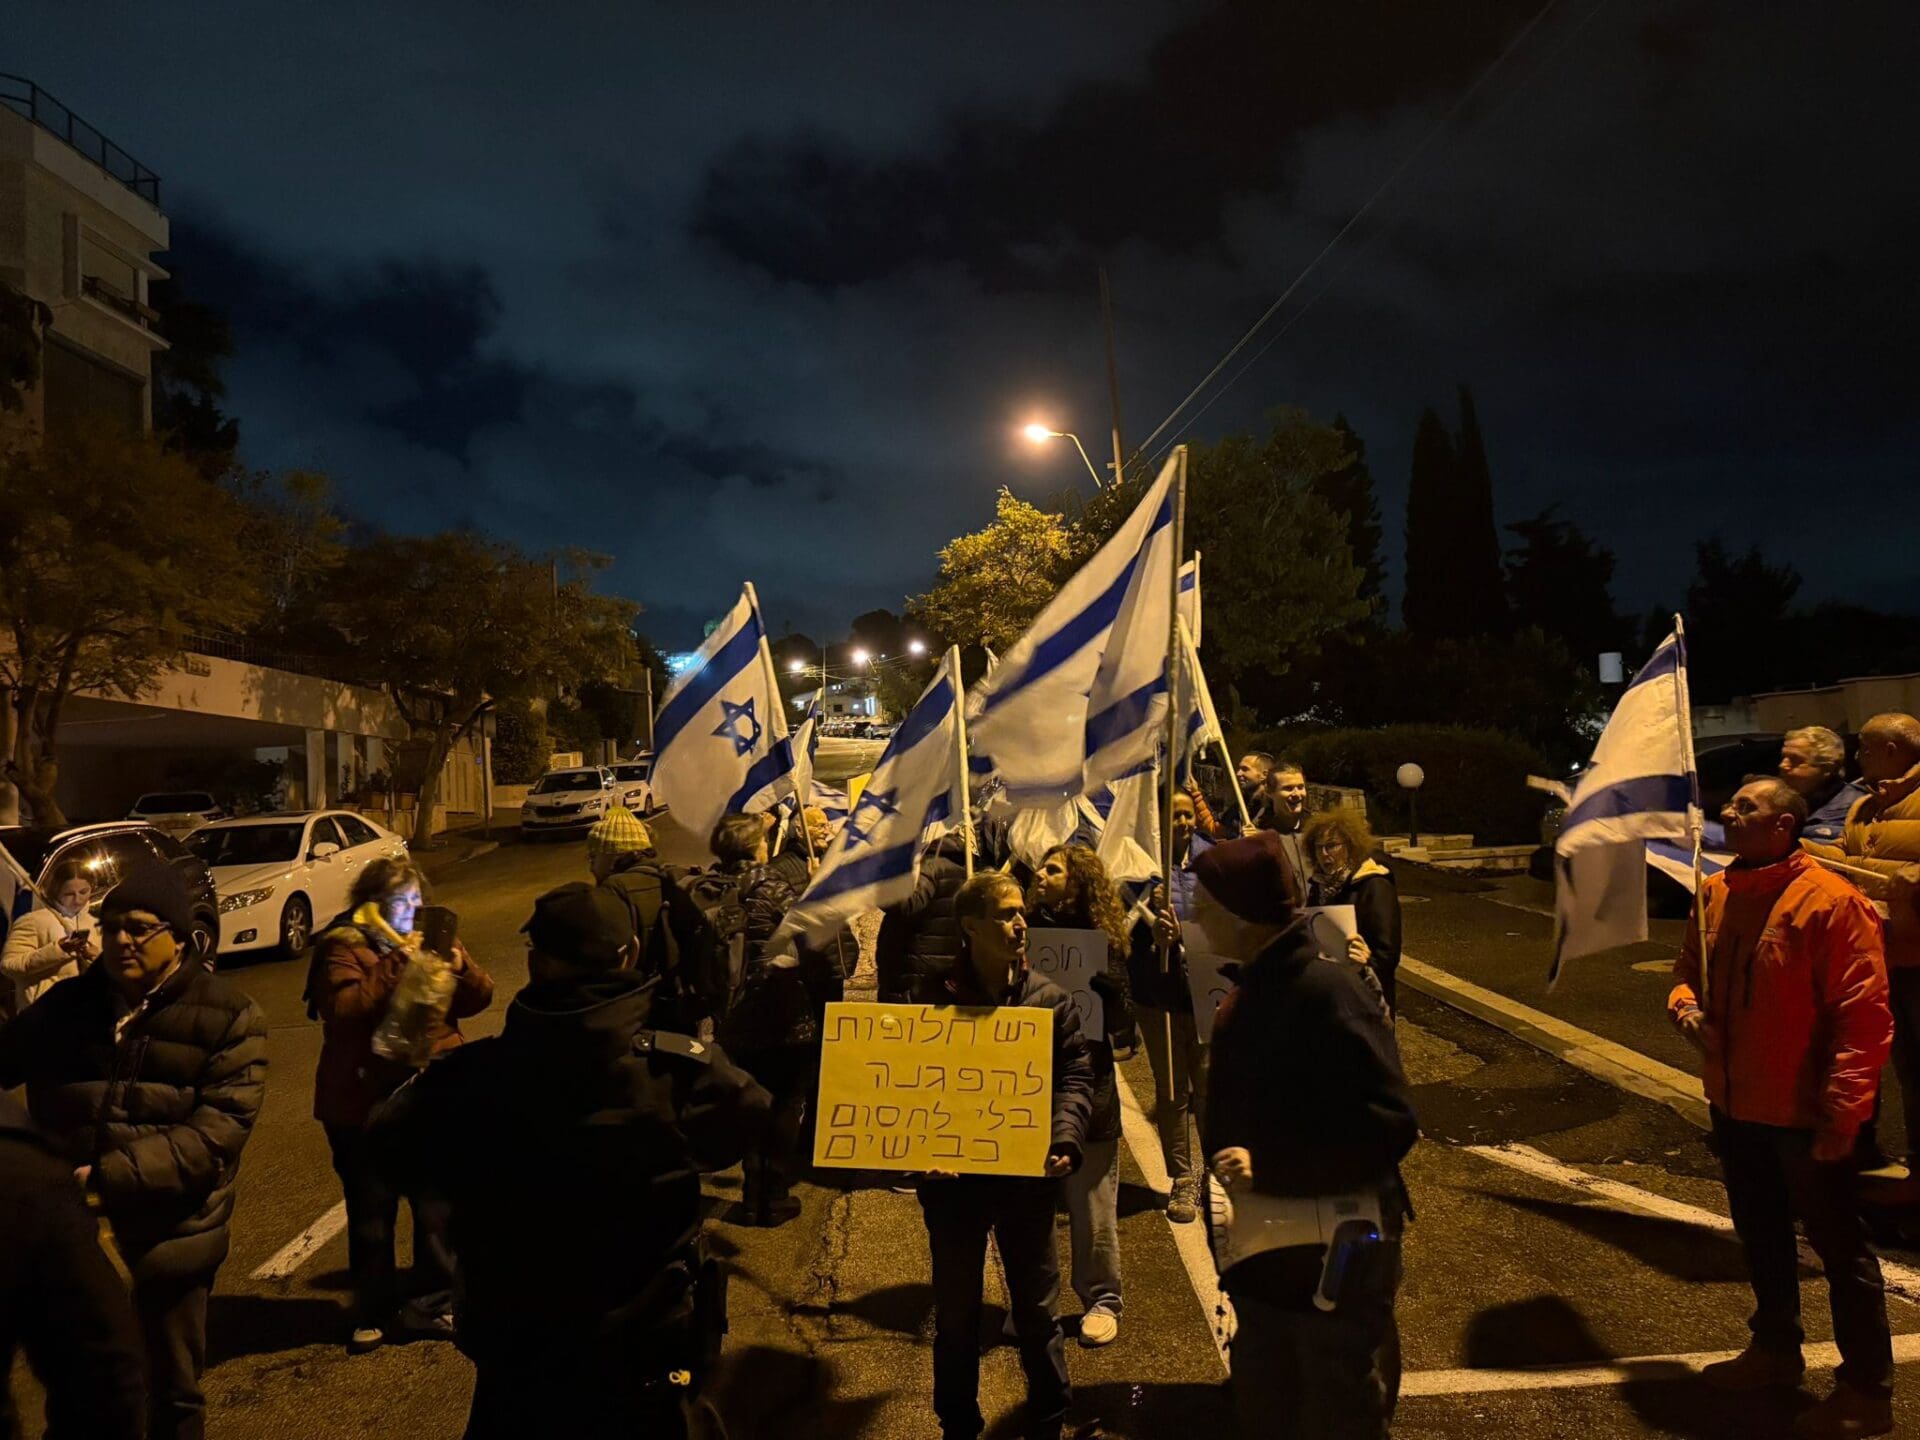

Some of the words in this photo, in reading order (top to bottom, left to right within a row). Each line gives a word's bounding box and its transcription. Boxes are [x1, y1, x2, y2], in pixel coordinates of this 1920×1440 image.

[1031, 943, 1083, 974] חופ
[824, 1007, 977, 1047] חלופות
[993, 1019, 1037, 1043] יש
[865, 1060, 1044, 1097] להפגנה
[830, 1100, 952, 1131] לחסום
[975, 1100, 1040, 1132] בלי
[824, 1133, 1000, 1163] כבישים
